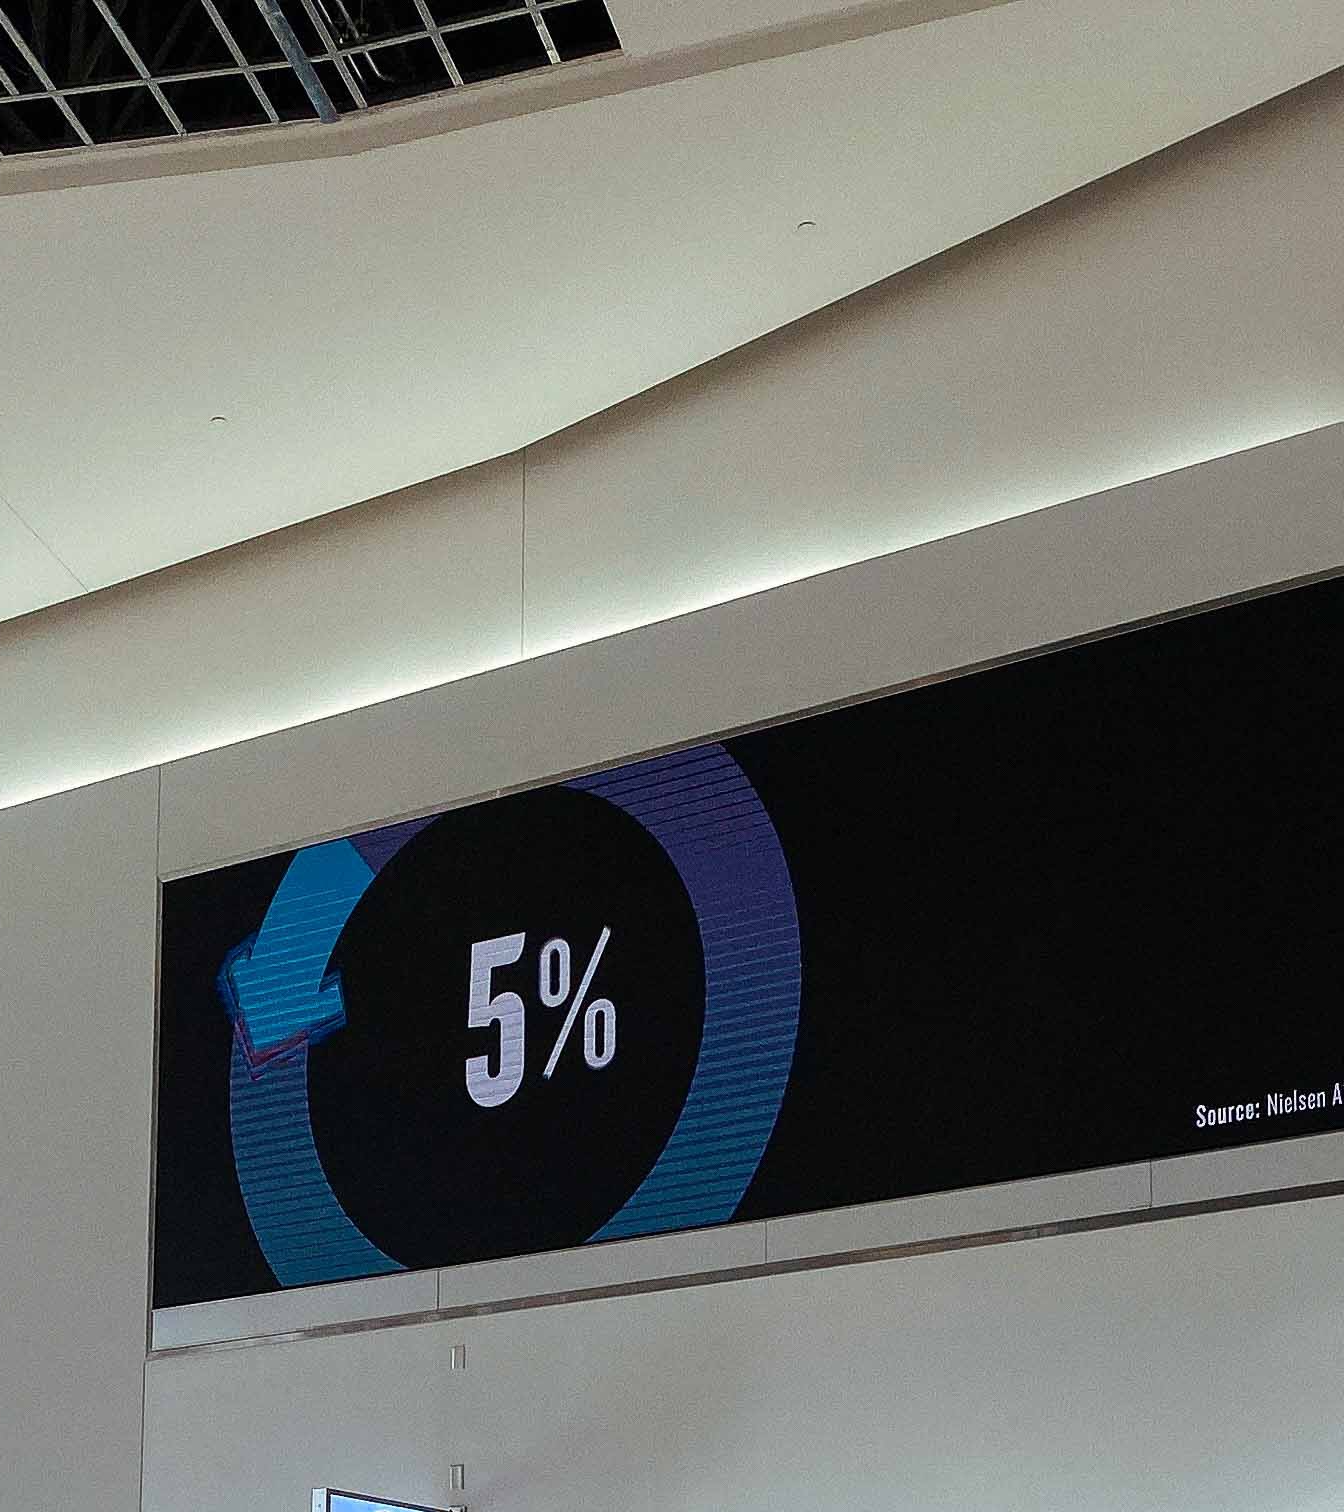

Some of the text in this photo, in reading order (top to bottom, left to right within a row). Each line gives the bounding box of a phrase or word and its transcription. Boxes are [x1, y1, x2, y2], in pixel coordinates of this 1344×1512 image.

[465, 927, 616, 1108] 5%
[1195, 1102, 1260, 1128] Source:
[1267, 1090, 1326, 1117] Nielsen
